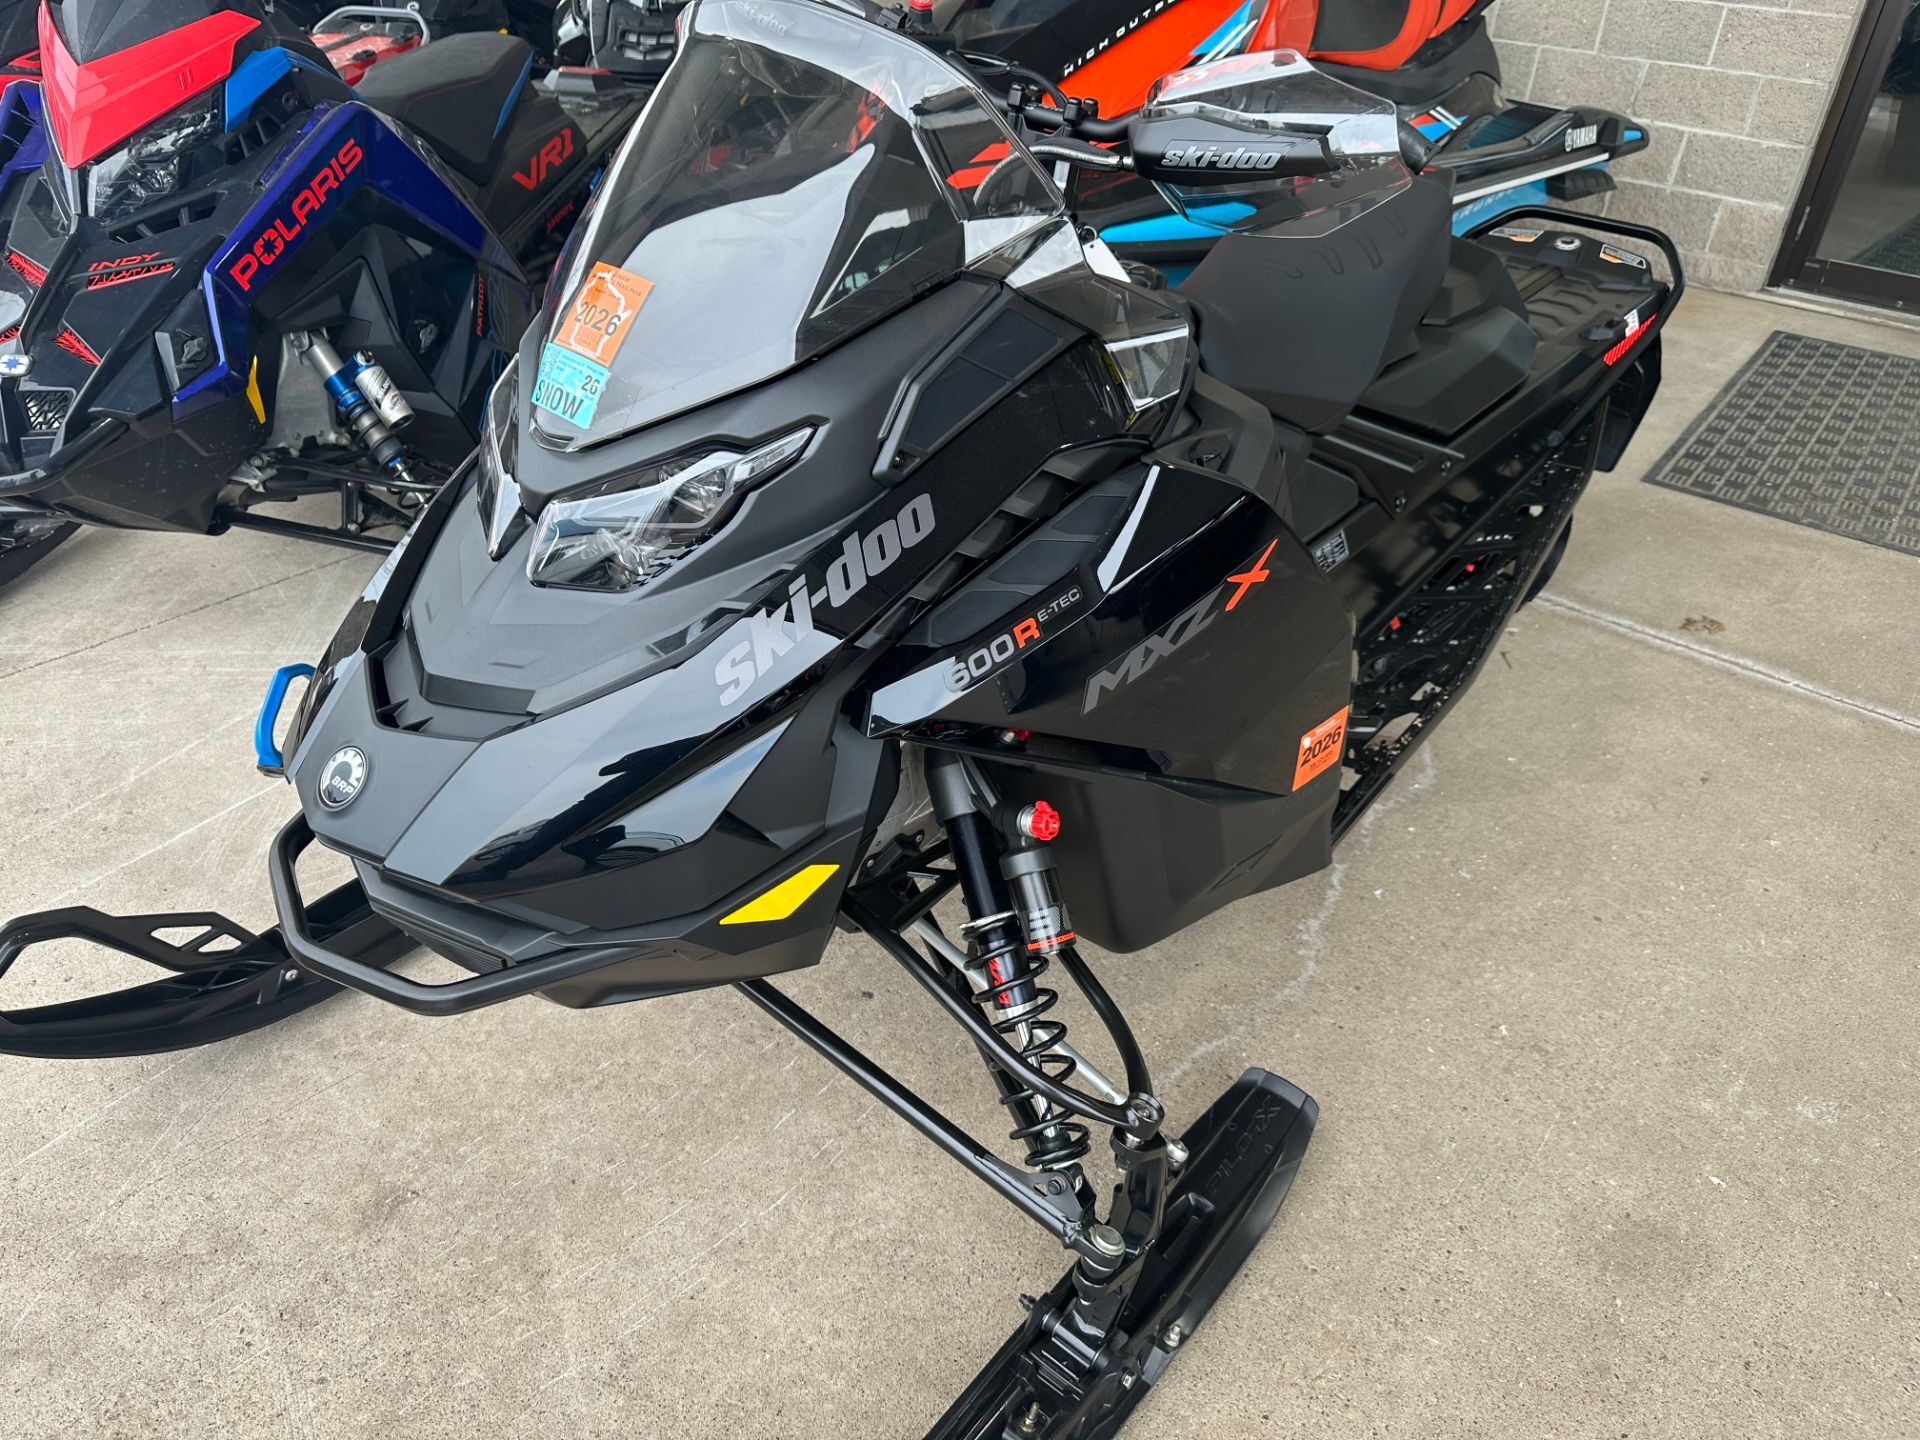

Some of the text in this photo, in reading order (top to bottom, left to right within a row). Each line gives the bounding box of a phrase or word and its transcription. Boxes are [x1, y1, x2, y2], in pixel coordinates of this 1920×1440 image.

[1064, 38, 1109, 77] HIGH
[1572, 124, 1598, 149] YAMAHA
[512, 127, 574, 191] VR1
[1161, 146, 1282, 170] ski-doo
[229, 137, 363, 292] POLARIS
[88, 251, 161, 272] INDY
[476, 273, 484, 337] PATRIOT
[574, 301, 622, 337] 2026
[535, 379, 585, 420] SNOW
[581, 374, 599, 395] 26
[714, 492, 936, 708] ski-doo
[1037, 587, 1081, 623] E-TEC
[1081, 582, 1227, 718] MXZ
[1300, 725, 1342, 768] 2026
[331, 775, 355, 794] BRP
